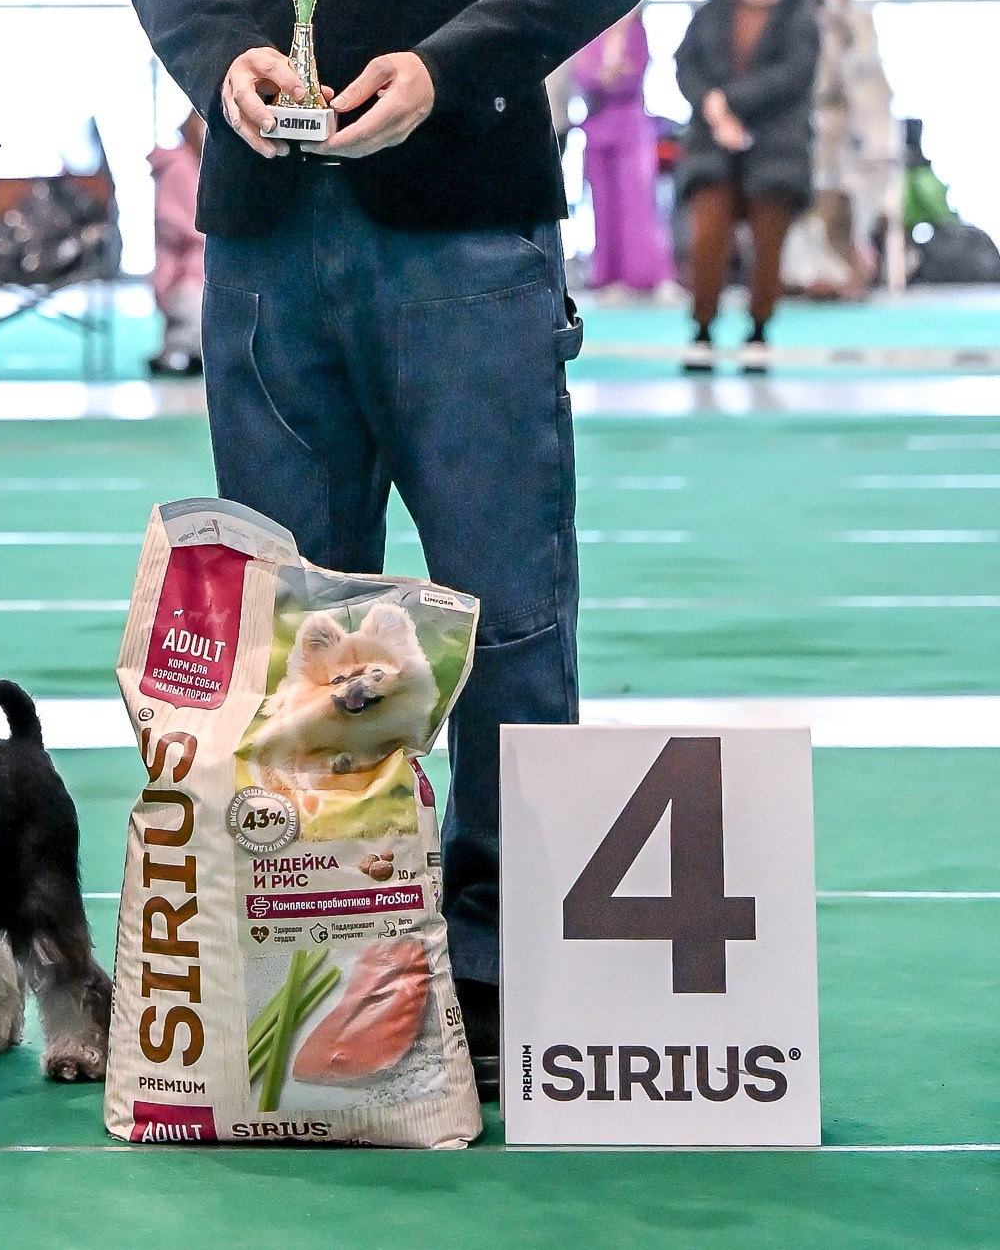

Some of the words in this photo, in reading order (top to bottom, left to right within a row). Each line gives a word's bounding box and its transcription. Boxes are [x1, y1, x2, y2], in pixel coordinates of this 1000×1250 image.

[162, 627, 226, 663] ADULT
[168, 658, 190, 671] КОРМ
[190, 663, 208, 675] ДЛЯ
[153, 668, 194, 685] ВЗРОСЛЫХ
[195, 677, 221, 691] СОБАК
[155, 682, 185, 696] МАЛЫХ
[185, 688, 212, 702] ПОРОД
[230, 794, 245, 827] ВЫСОКОЕ
[242, 807, 286, 831] 43%
[283, 802, 297, 841] ЖИВОТНЫХ
[235, 832, 286, 853] ИНГРЕДИЕНТОВ
[253, 853, 340, 873] ИНДЕЙКА
[563, 737, 756, 994] 4
[254, 875, 266, 889] И
[271, 874, 309, 889] РИС
[398, 869, 409, 881] 10
[272, 900, 316, 911] Комплекс
[317, 897, 371, 911] пробиотиков
[375, 892, 419, 906] ProStor+
[523, 1044, 533, 1101] PREMIUM
[138, 1076, 206, 1094] PREMIUM
[141, 1121, 202, 1142] ADULT
